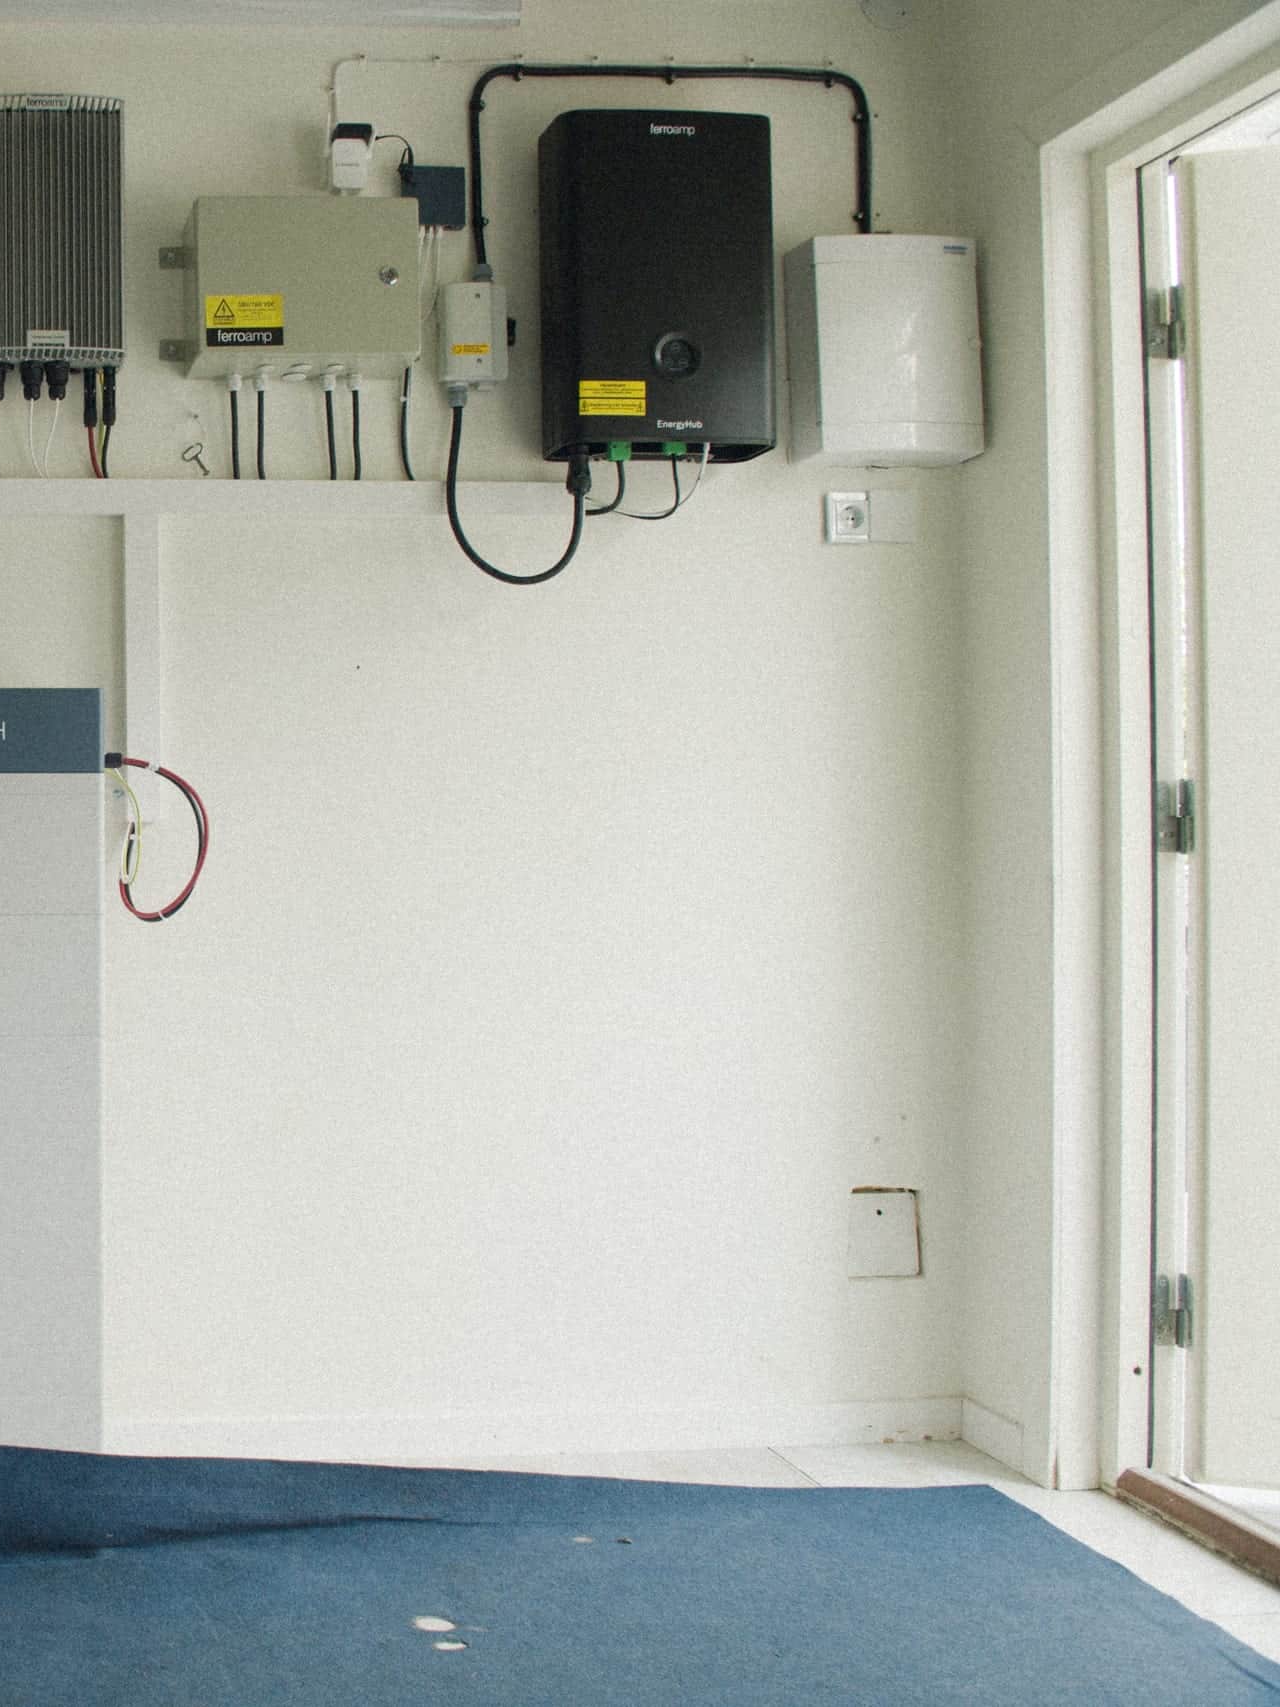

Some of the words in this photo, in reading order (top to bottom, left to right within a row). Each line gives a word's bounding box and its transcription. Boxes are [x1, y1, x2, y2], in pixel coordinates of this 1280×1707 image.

[650, 122, 696, 137] ferroamp
[217, 329, 273, 344] ferroamp
[656, 419, 703, 431] EnergyHub
